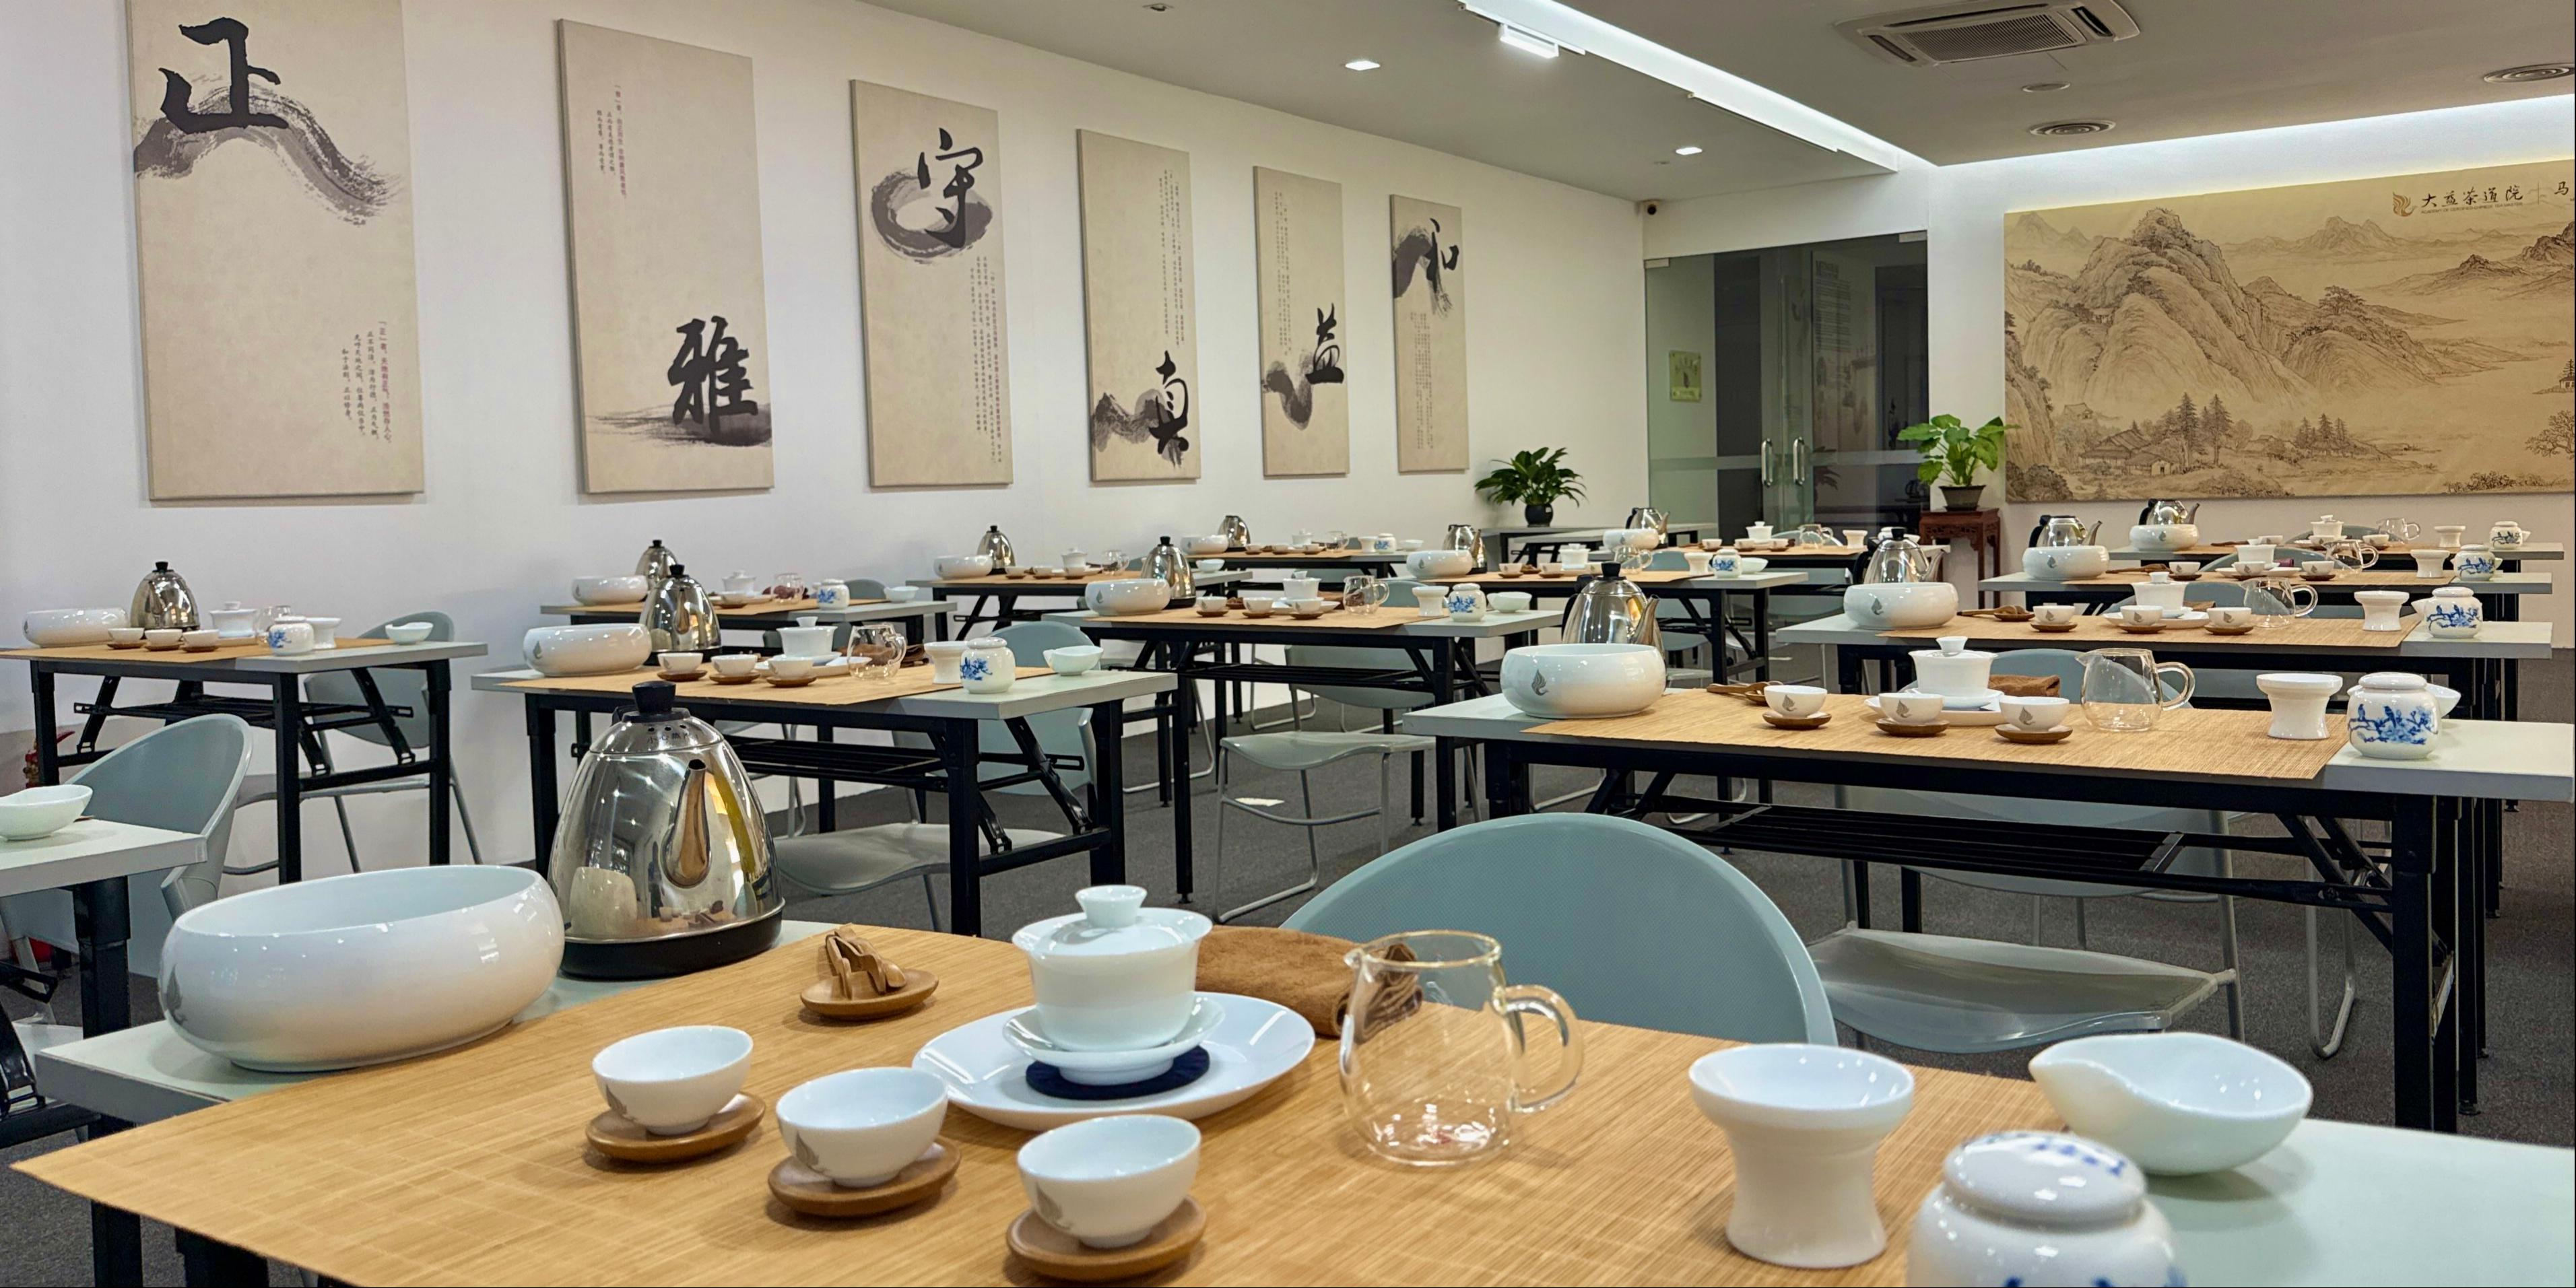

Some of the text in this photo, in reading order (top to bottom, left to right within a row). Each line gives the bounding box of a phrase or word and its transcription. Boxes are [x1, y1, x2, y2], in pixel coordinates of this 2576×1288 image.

[159, 17, 289, 135] 正
[917, 128, 983, 248] 守
[2422, 181, 2569, 207] 大益茶道院 马
[1424, 218, 1459, 294] 和
[667, 316, 758, 437] 雅
[1305, 303, 1344, 384] 益
[1149, 351, 1189, 454] 真
